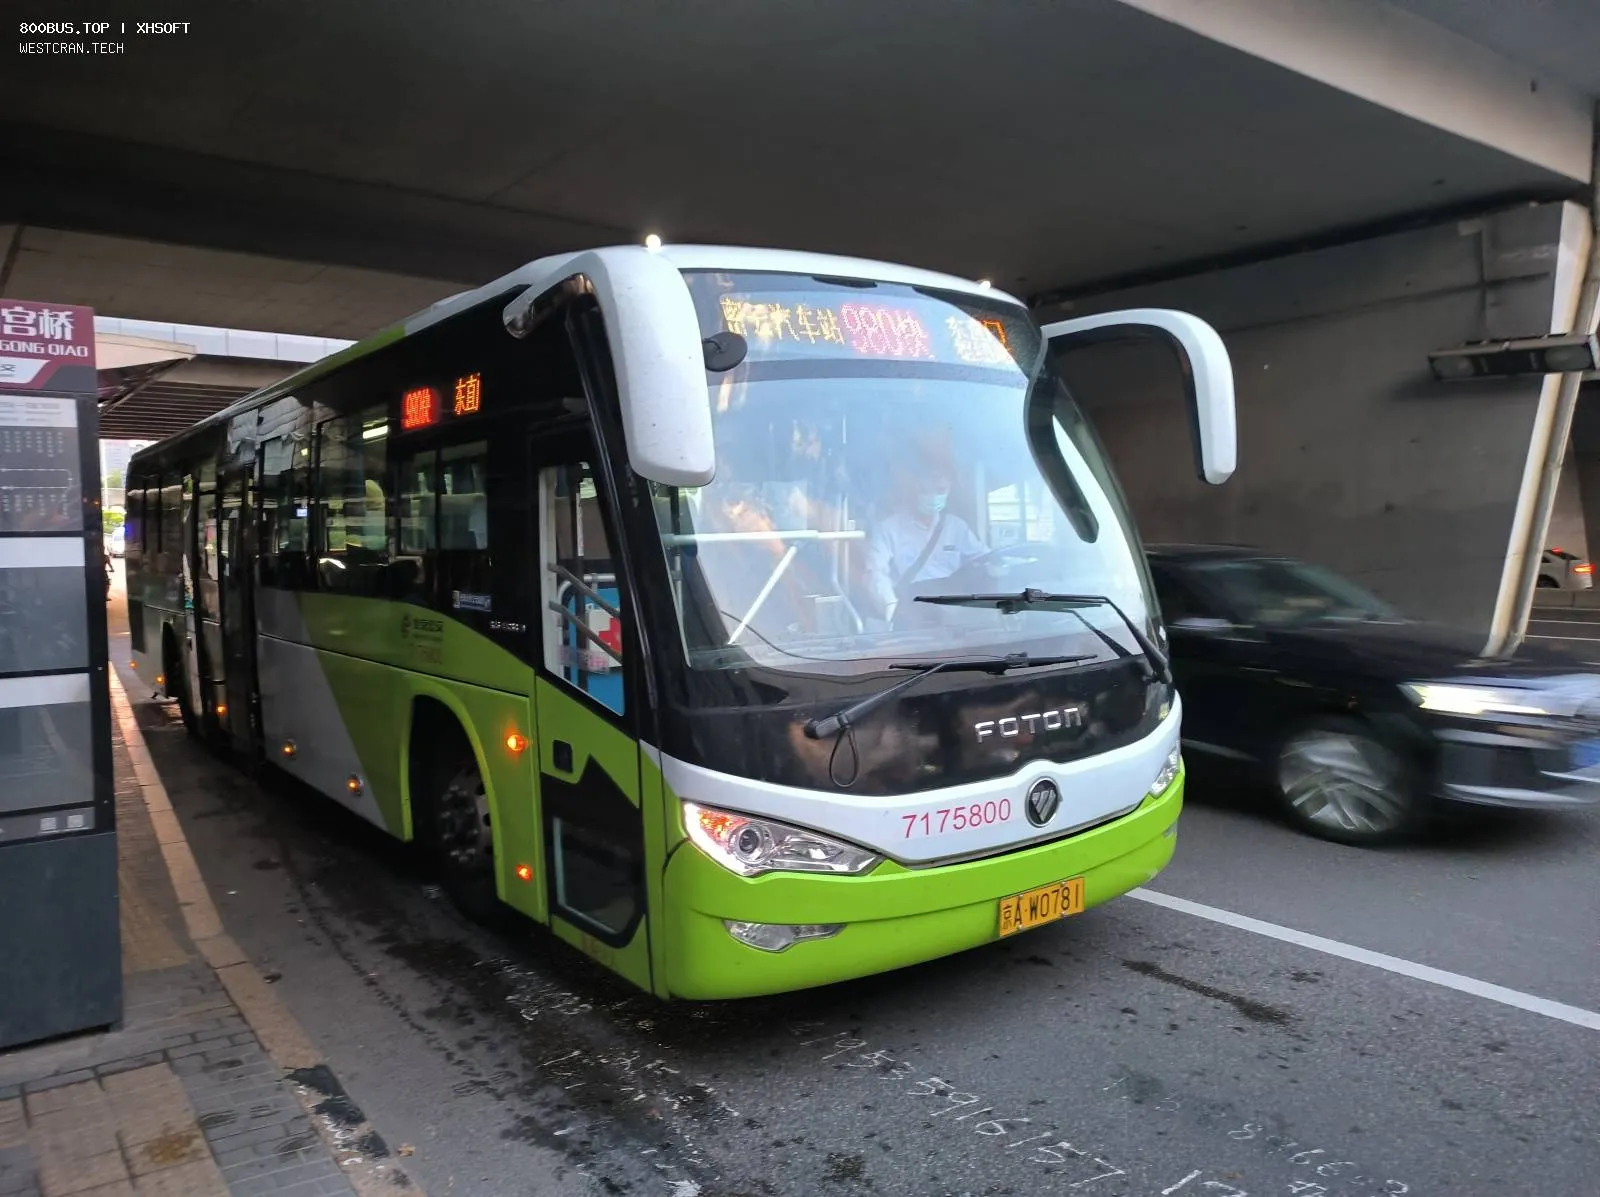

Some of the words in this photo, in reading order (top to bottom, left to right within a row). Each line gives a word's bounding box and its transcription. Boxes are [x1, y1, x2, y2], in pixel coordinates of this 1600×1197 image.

[1, 306, 74, 340] 宫桥
[48, 343, 88, 357] QIAO
[974, 706, 1082, 744] FOTON
[902, 797, 1012, 839] 7175800
